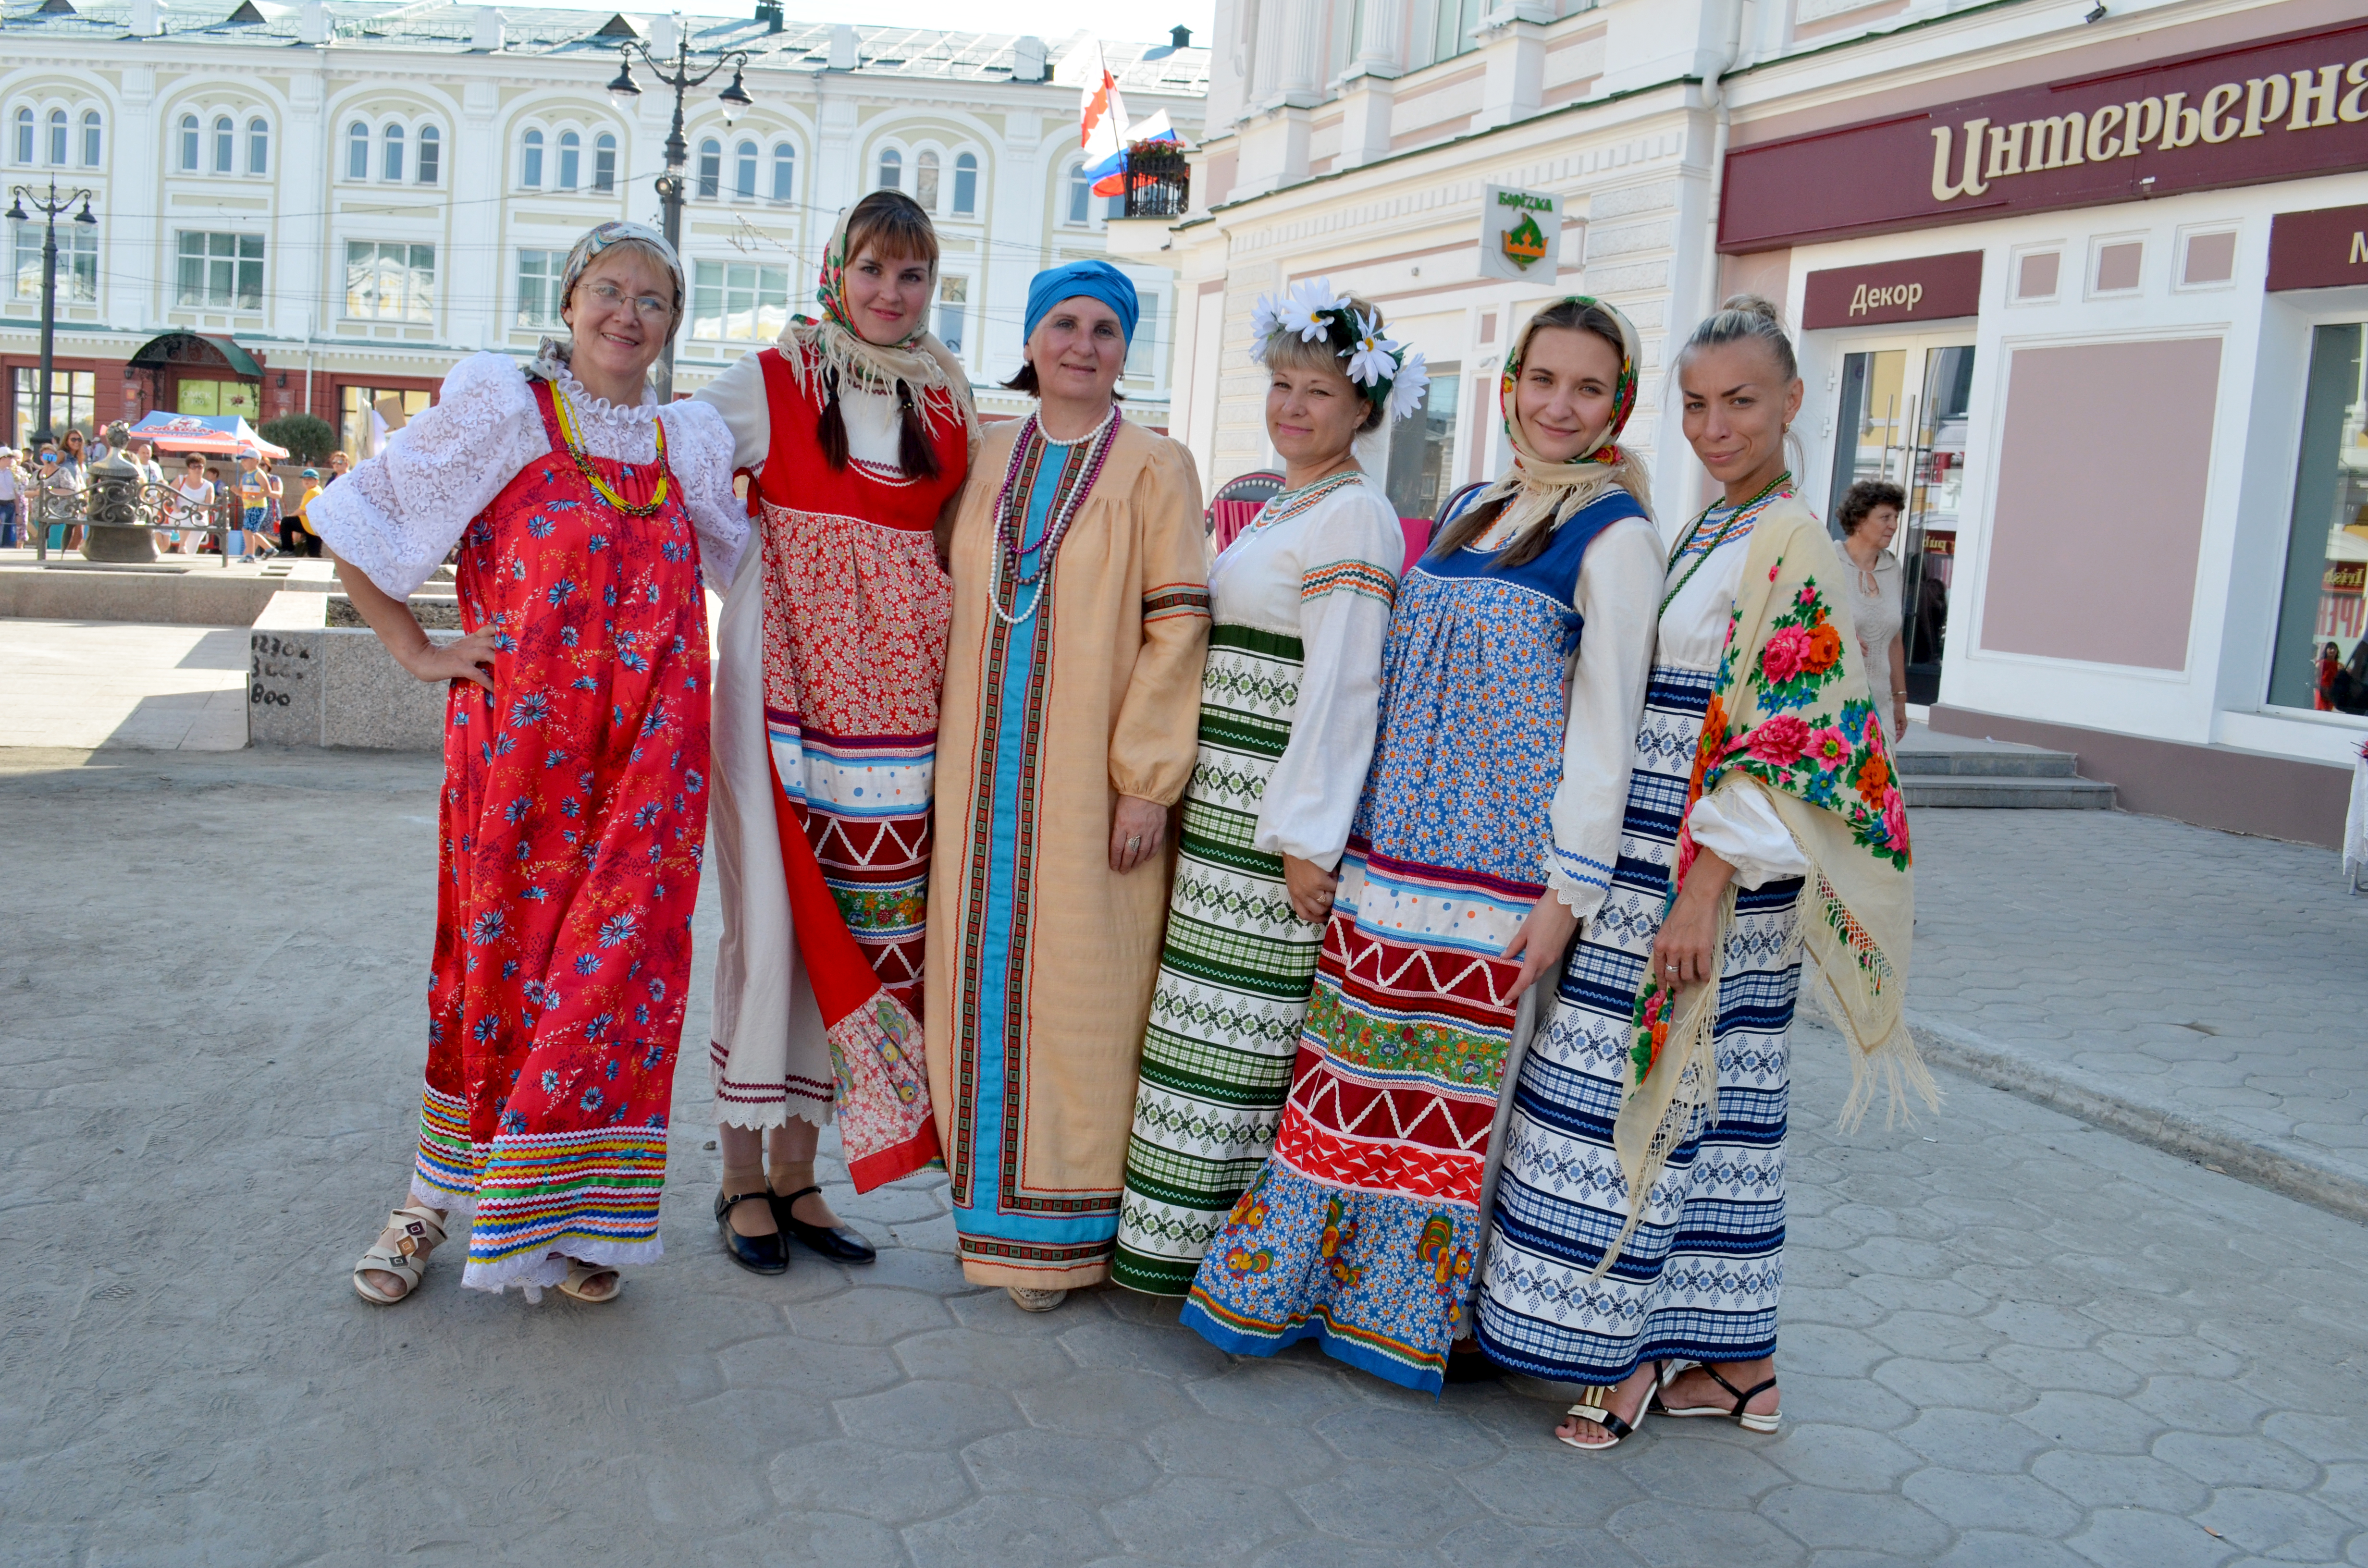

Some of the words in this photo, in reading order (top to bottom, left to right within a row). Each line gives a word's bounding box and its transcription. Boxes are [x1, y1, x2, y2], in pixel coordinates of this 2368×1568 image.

[1931, 58, 2368, 201] Интерьерна
[1850, 282, 1923, 317] Декор
[182, 391, 211, 399] ОМСК
[251, 683, 291, 706] 800
